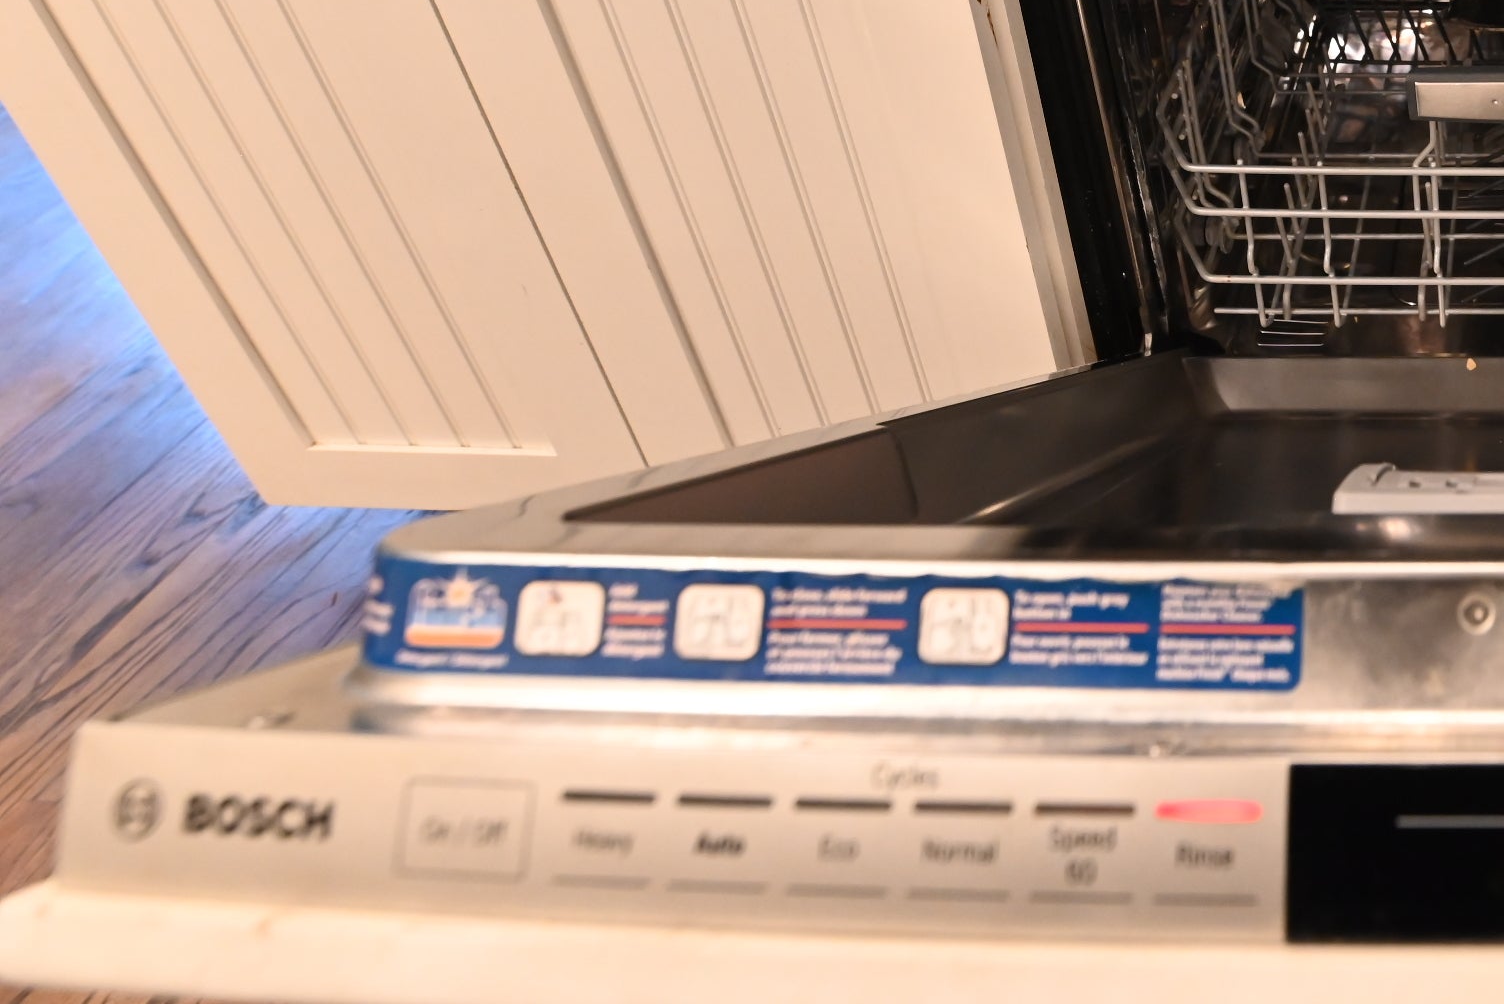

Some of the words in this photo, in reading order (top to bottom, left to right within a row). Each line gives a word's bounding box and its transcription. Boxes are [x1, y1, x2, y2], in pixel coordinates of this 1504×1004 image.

[873, 767, 937, 790] Cycles
[183, 795, 334, 840] BOSCH
[694, 834, 744, 856] Auto
[924, 839, 996, 863] Normal
[1050, 826, 1116, 854] Speed
[1177, 844, 1234, 868] Rinse
